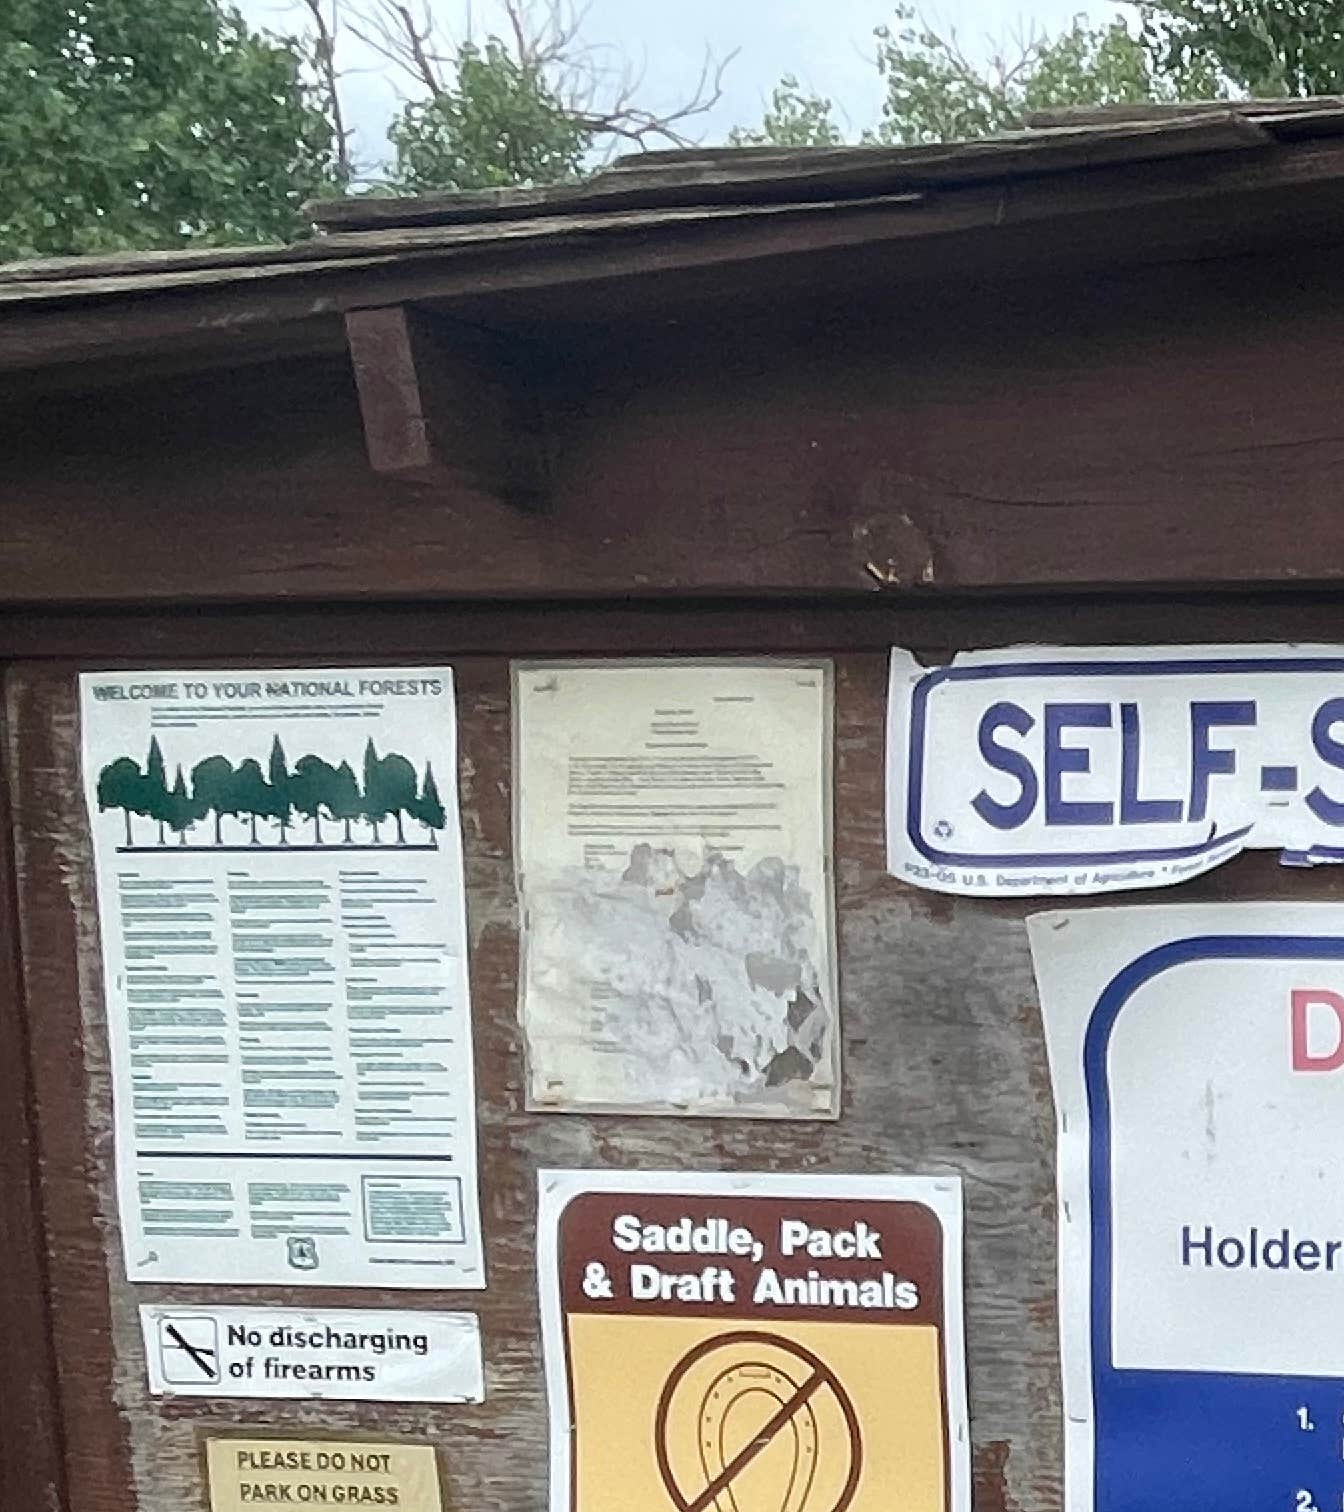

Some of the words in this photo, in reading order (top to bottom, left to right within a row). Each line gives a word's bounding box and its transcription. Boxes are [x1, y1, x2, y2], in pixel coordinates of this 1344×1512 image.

[184, 683, 208, 698] TO
[212, 682, 262, 698] YOUR
[358, 679, 442, 695] FORESTS
[612, 1214, 764, 1263] Saddle,
[780, 1220, 882, 1259] Pack
[583, 1262, 614, 1299] &
[630, 1264, 735, 1302] Draft
[752, 1268, 920, 1310] Animals
[227, 1324, 261, 1346] No
[268, 1326, 429, 1355] discharging
[229, 1357, 255, 1378] of
[264, 1357, 376, 1381] firearms
[1297, 1407, 1315, 1431] 1.
[238, 1452, 311, 1472] PLEASE
[318, 1453, 345, 1472] DO
[352, 1454, 391, 1473] NOT
[240, 1482, 292, 1502] PARK
[298, 1485, 326, 1502] ON
[333, 1486, 399, 1505] GRASS
